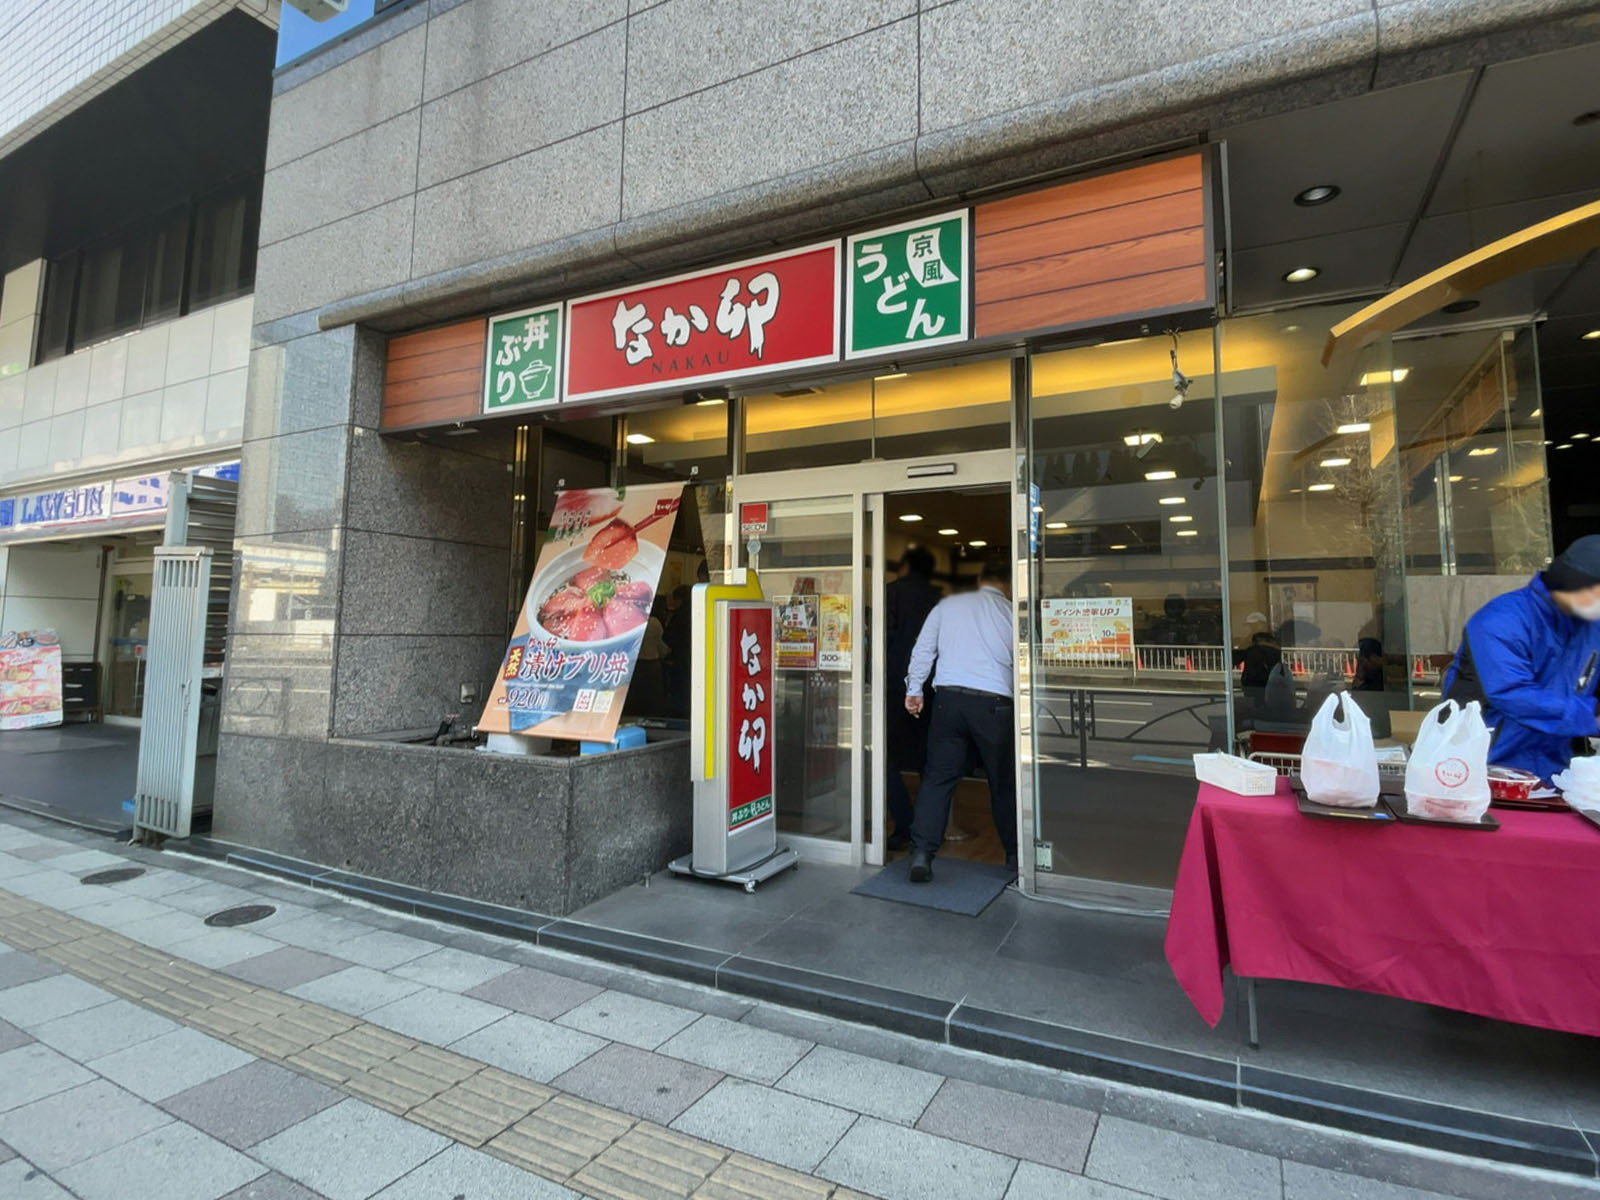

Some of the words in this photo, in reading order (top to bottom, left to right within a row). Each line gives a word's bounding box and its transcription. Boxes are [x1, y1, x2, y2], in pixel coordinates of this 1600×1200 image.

[857, 243, 945, 339] うどん
[912, 234, 943, 283] 京風
[495, 314, 549, 403] 丼ぶり
[611, 271, 780, 366] なか卯
[652, 351, 730, 374] NAKAU
[20, 486, 105, 524] LAWSON
[738, 628, 766, 776] なか卯
